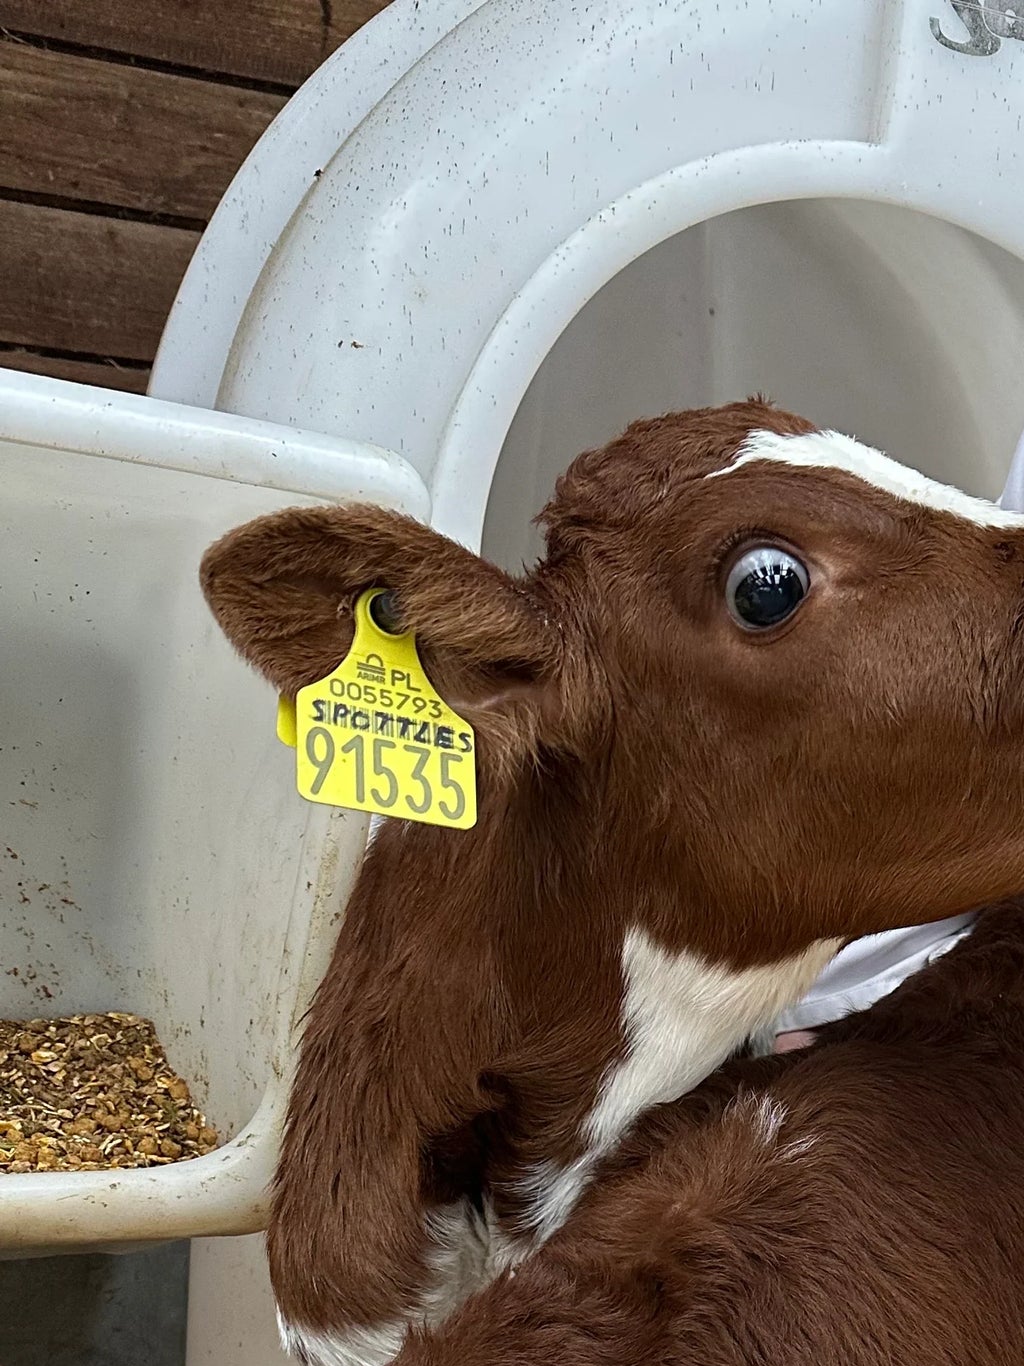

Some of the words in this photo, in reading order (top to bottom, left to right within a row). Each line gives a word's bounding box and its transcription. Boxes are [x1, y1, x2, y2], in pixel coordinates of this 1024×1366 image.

[330, 679, 442, 719] 0055793
[391, 670, 421, 692] PL
[311, 699, 472, 753] SPOTTLES
[306, 727, 465, 819] 91535
